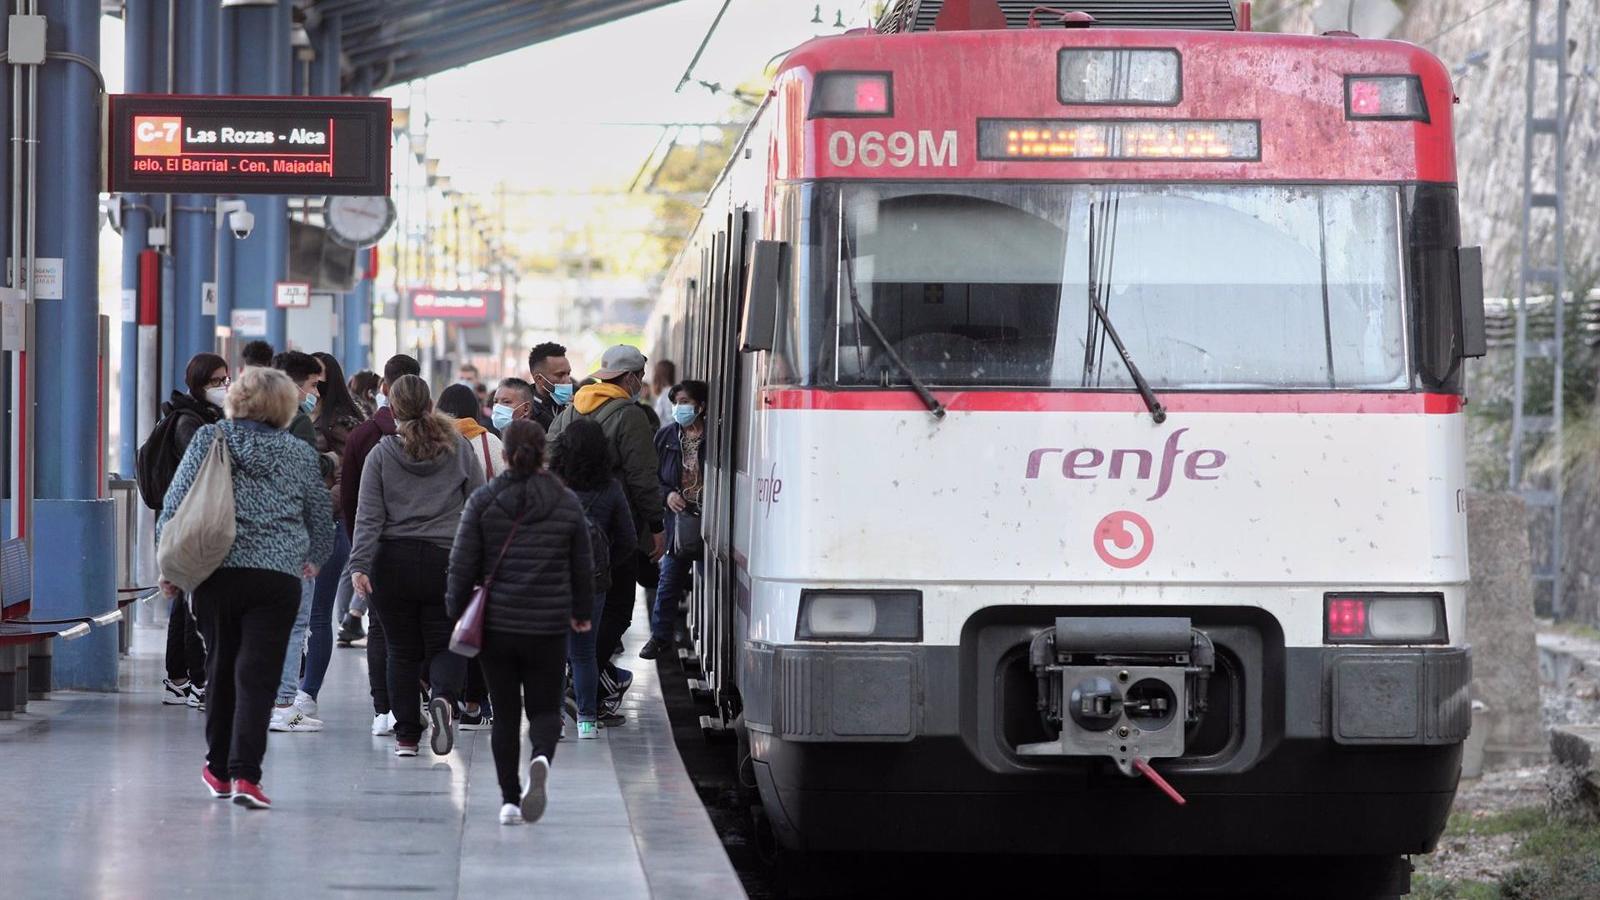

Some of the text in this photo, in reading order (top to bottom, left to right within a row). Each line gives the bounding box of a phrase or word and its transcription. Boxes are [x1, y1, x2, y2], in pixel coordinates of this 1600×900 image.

[137, 121, 179, 143] C-7
[185, 127, 217, 143] Las
[221, 127, 275, 144] Rozas
[289, 128, 326, 144] Alca
[828, 130, 958, 168] 069M
[166, 158, 179, 171] El
[182, 159, 228, 172] Barrial
[273, 160, 331, 174] Majadah
[1025, 427, 1227, 502] renfe
